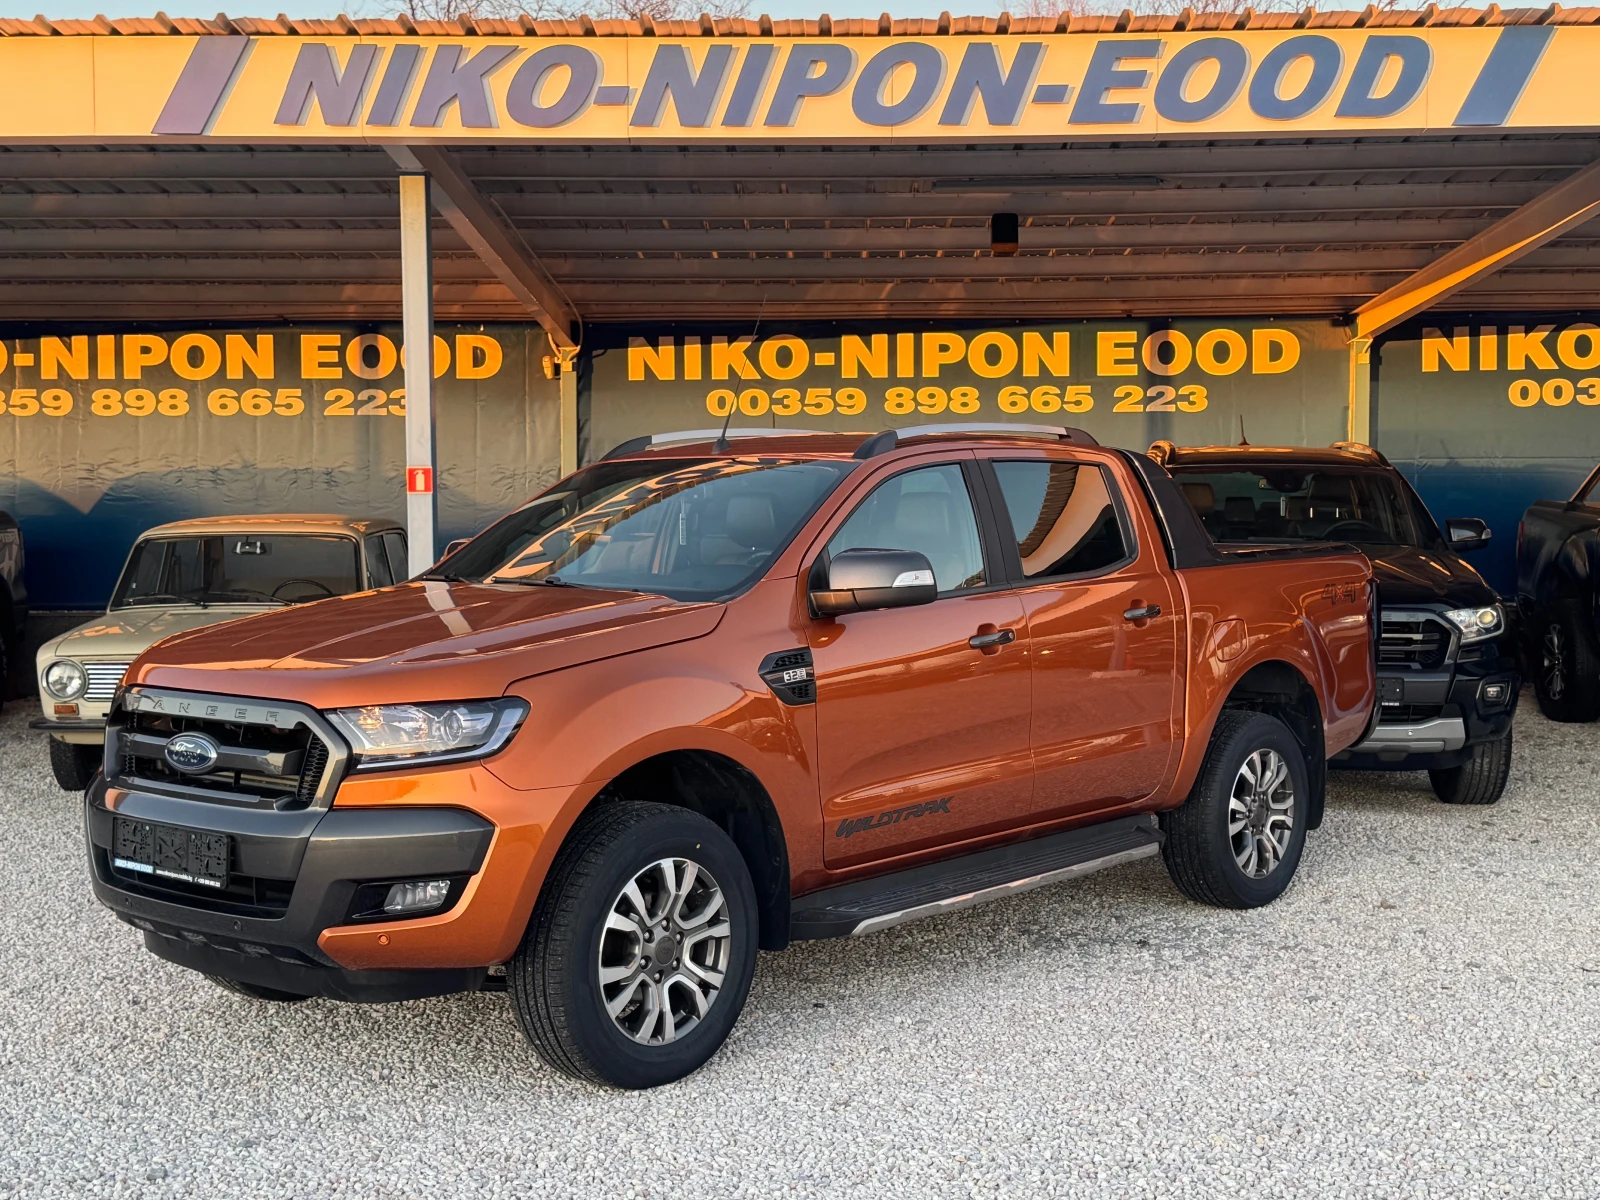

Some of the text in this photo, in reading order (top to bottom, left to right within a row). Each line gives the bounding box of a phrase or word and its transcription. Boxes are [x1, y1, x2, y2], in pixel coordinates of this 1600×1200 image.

[274, 34, 1432, 128] NIKO-NIPON-EOOD
[0, 333, 275, 380] -NIPON
[628, 328, 1301, 381] NIKO-NIPON EOOD
[1422, 322, 1600, 372] NIKO
[0, 388, 73, 416] 59
[91, 388, 190, 416] 898
[207, 388, 305, 416] 665
[706, 384, 1208, 416] 00359 898 665 223
[171, 741, 202, 764] Ford
[836, 796, 954, 838] WILDTRAK
